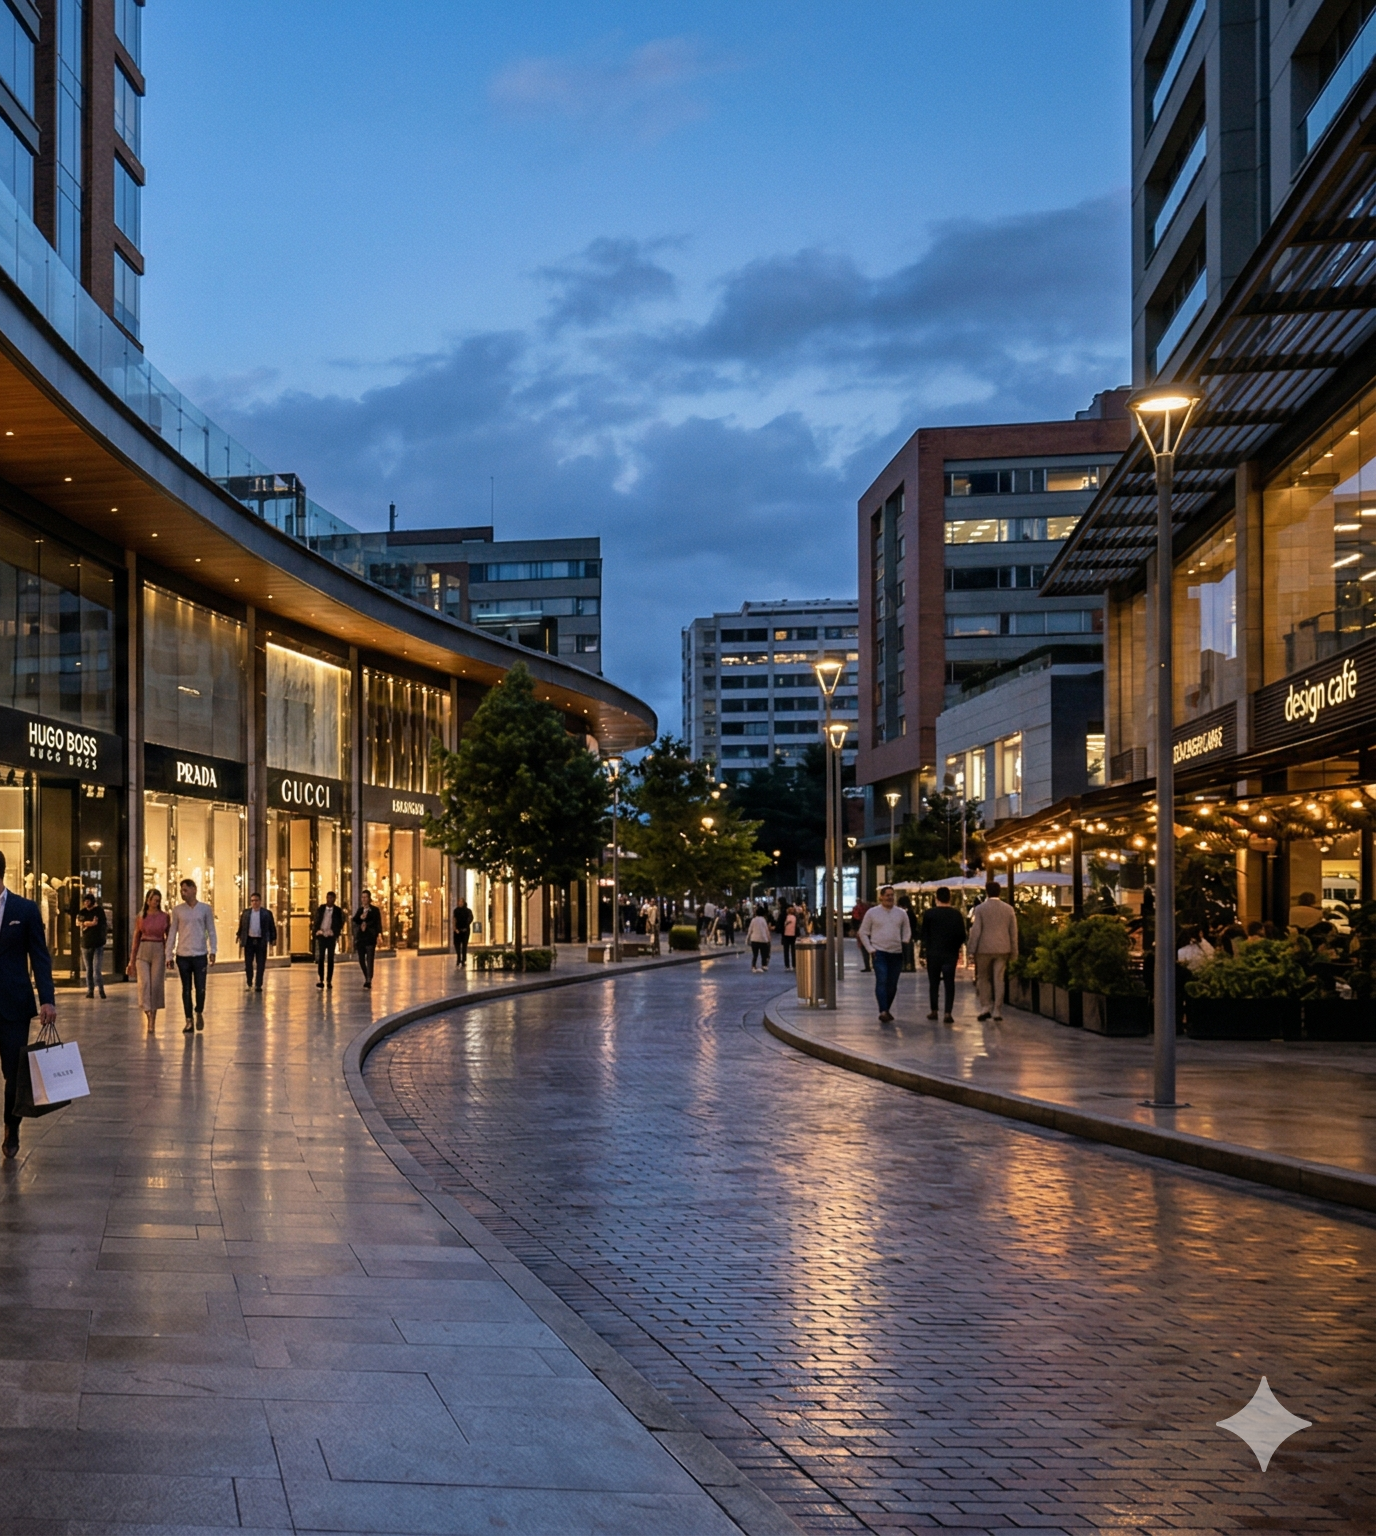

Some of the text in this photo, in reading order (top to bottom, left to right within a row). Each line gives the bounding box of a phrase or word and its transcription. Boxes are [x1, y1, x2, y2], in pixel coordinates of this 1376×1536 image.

[1285, 658, 1357, 723] design café
[28, 721, 98, 758] HUGO BOSS
[176, 761, 218, 789] PRADA
[281, 778, 330, 809] GUCCI
